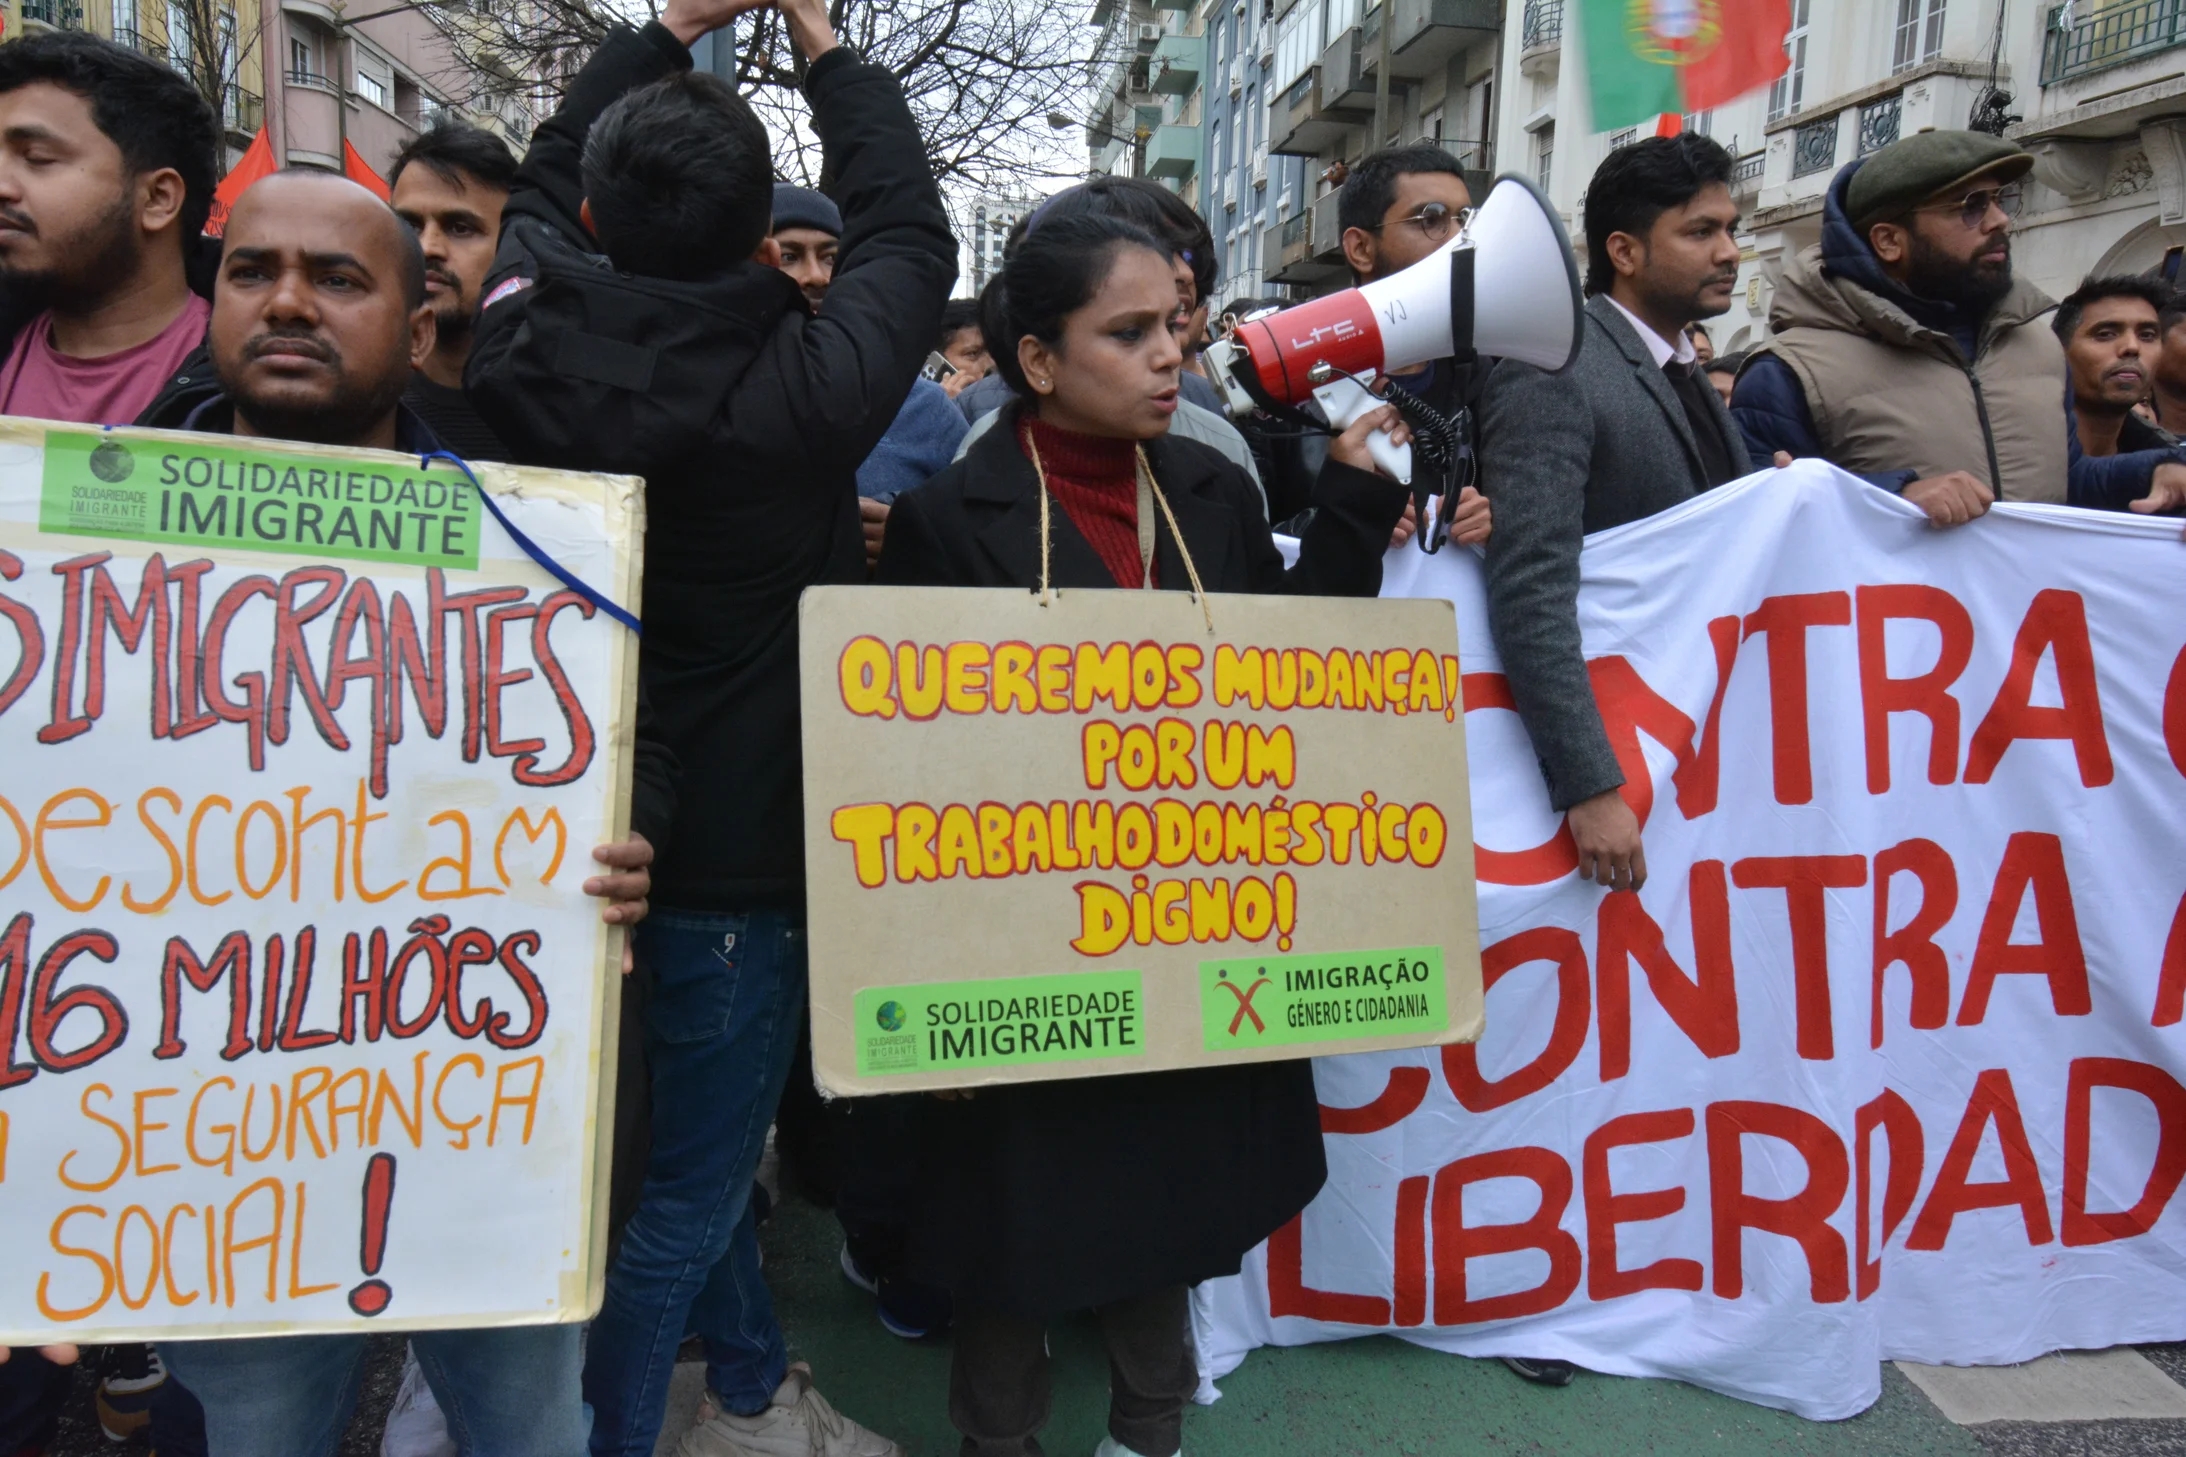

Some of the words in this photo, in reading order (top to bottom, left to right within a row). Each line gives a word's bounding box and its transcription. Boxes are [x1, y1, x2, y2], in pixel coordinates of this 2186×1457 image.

[70, 499, 147, 518] IMIGRANTE
[72, 485, 147, 504] SOLIDARIEDADE
[160, 453, 470, 512] SOLIDARIEDADE
[160, 489, 467, 556] IMIGRANTE
[838, 634, 1204, 722] QUEREMOS
[1213, 642, 1460, 723] MUDANÇA!
[1081, 717, 1198, 792] POR
[1202, 717, 1296, 791] UM
[831, 799, 1155, 889] TRABALHO
[1285, 957, 1430, 992] IMIGRAÇÃO
[926, 989, 1135, 1027] SOLIDARIEDADE
[1287, 998, 1341, 1029] GÉNERO
[1345, 999, 1353, 1024] E
[1355, 993, 1430, 1024] CIDADANIA
[929, 1015, 1136, 1061] IMIGRANTE
[57, 1050, 546, 1192] SEGURANÇA
